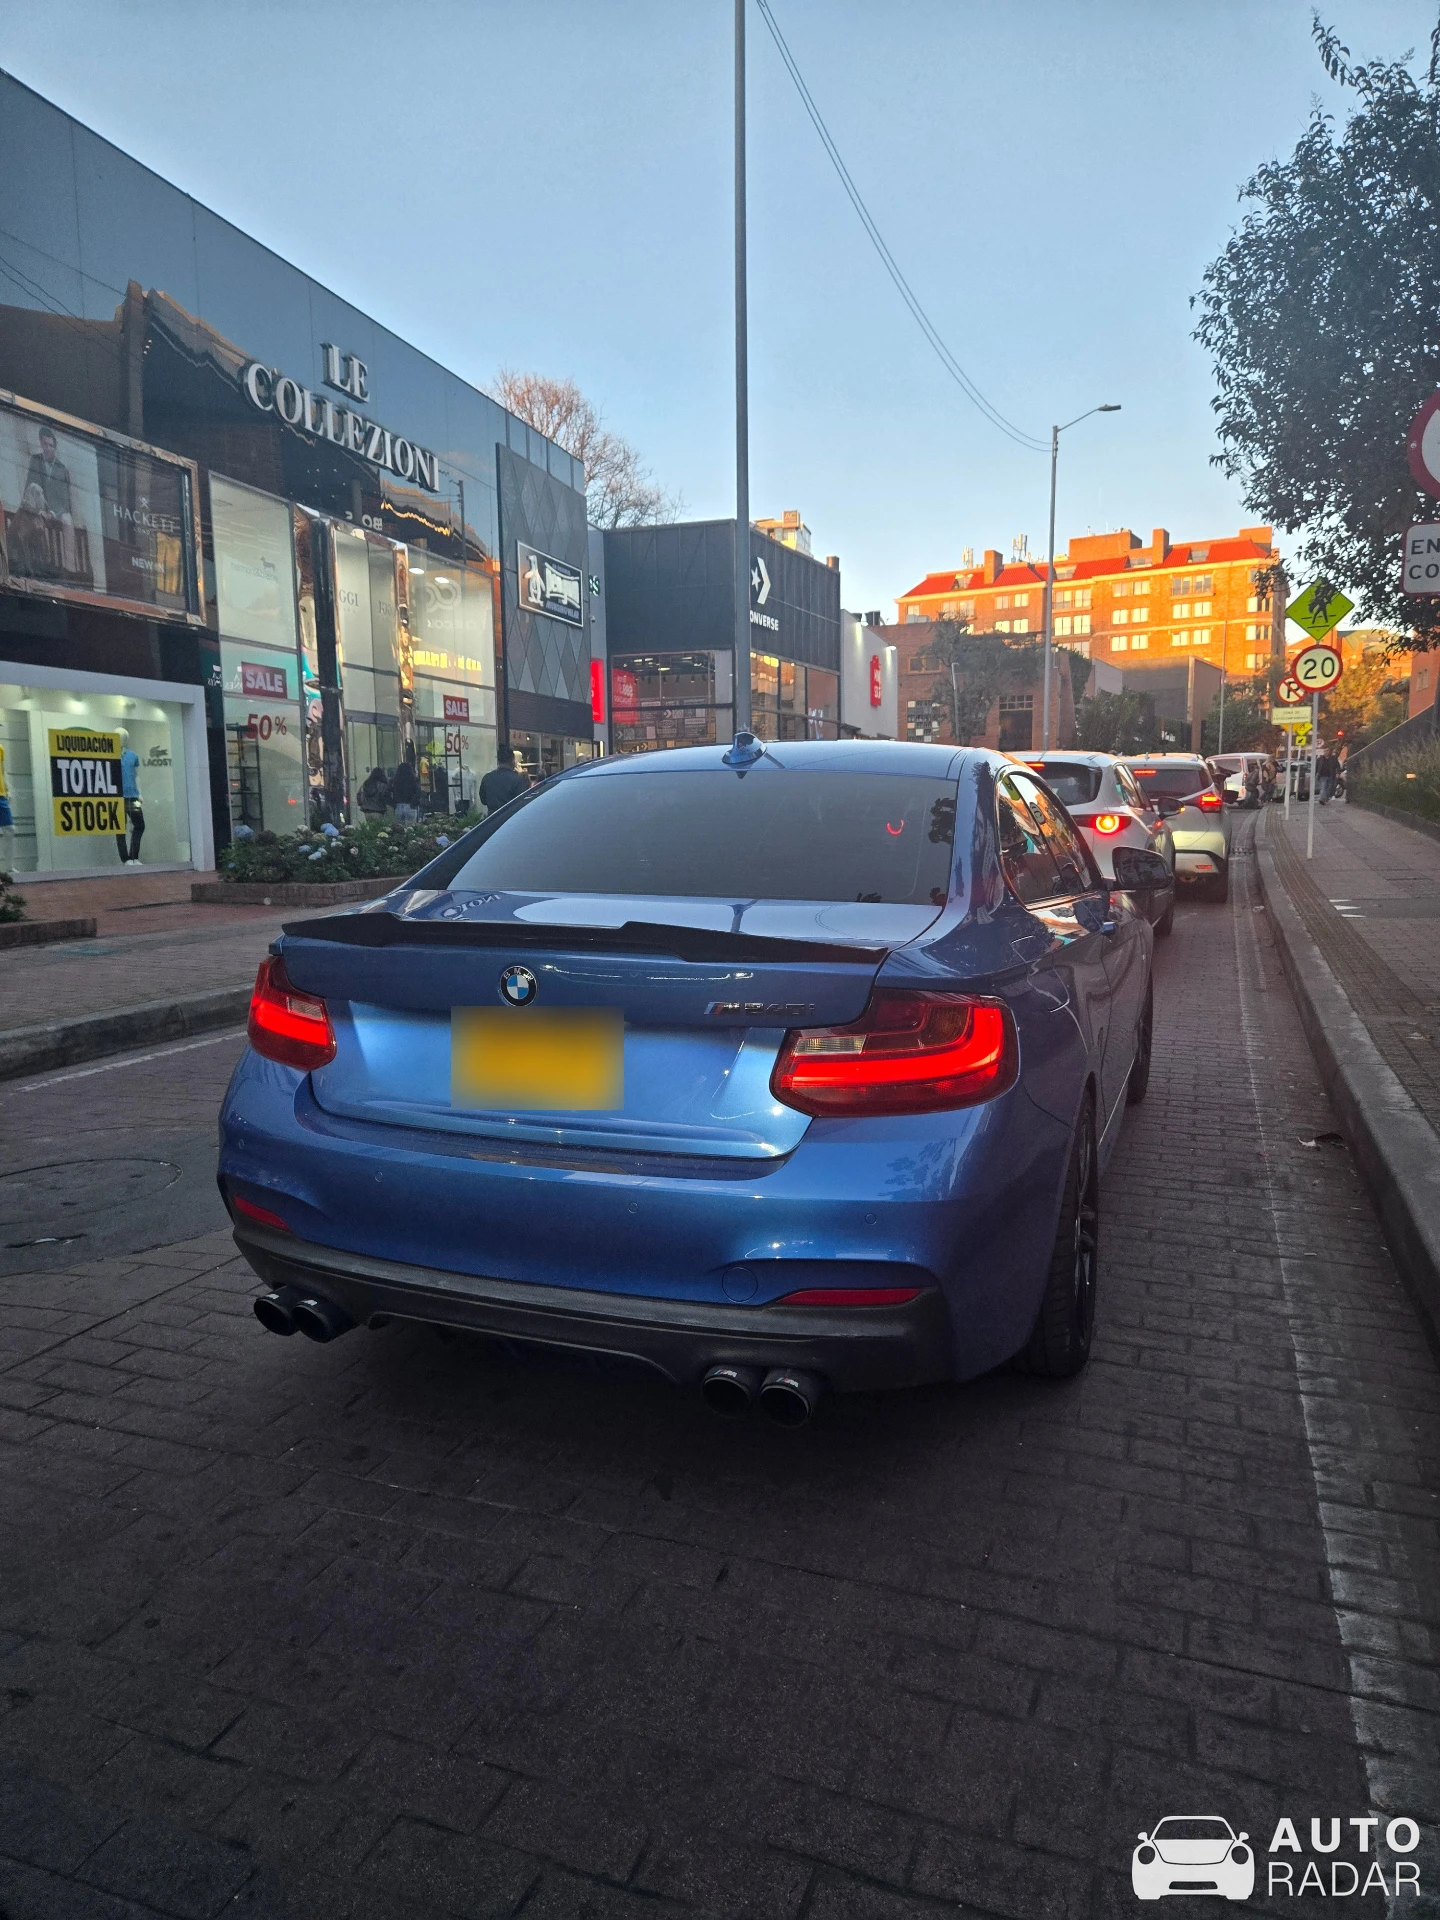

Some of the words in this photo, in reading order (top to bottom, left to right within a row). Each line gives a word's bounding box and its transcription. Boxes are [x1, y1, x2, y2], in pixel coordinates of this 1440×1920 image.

[321, 343, 370, 403] LE
[247, 363, 440, 493] COLLEZIONI
[113, 504, 175, 533] HACKETT
[1408, 563, 1440, 580] CO
[339, 589, 359, 607] GGI
[749, 609, 779, 631] ONVERSE
[1303, 656, 1335, 680] 20
[245, 668, 284, 693] SALE
[445, 699, 468, 717] SALE
[246, 713, 287, 740] 50%
[56, 734, 114, 754] LIQUIDACIÓN
[446, 732, 469, 753] 50%
[56, 759, 118, 794] TOTAL
[60, 801, 121, 832] STOCK
